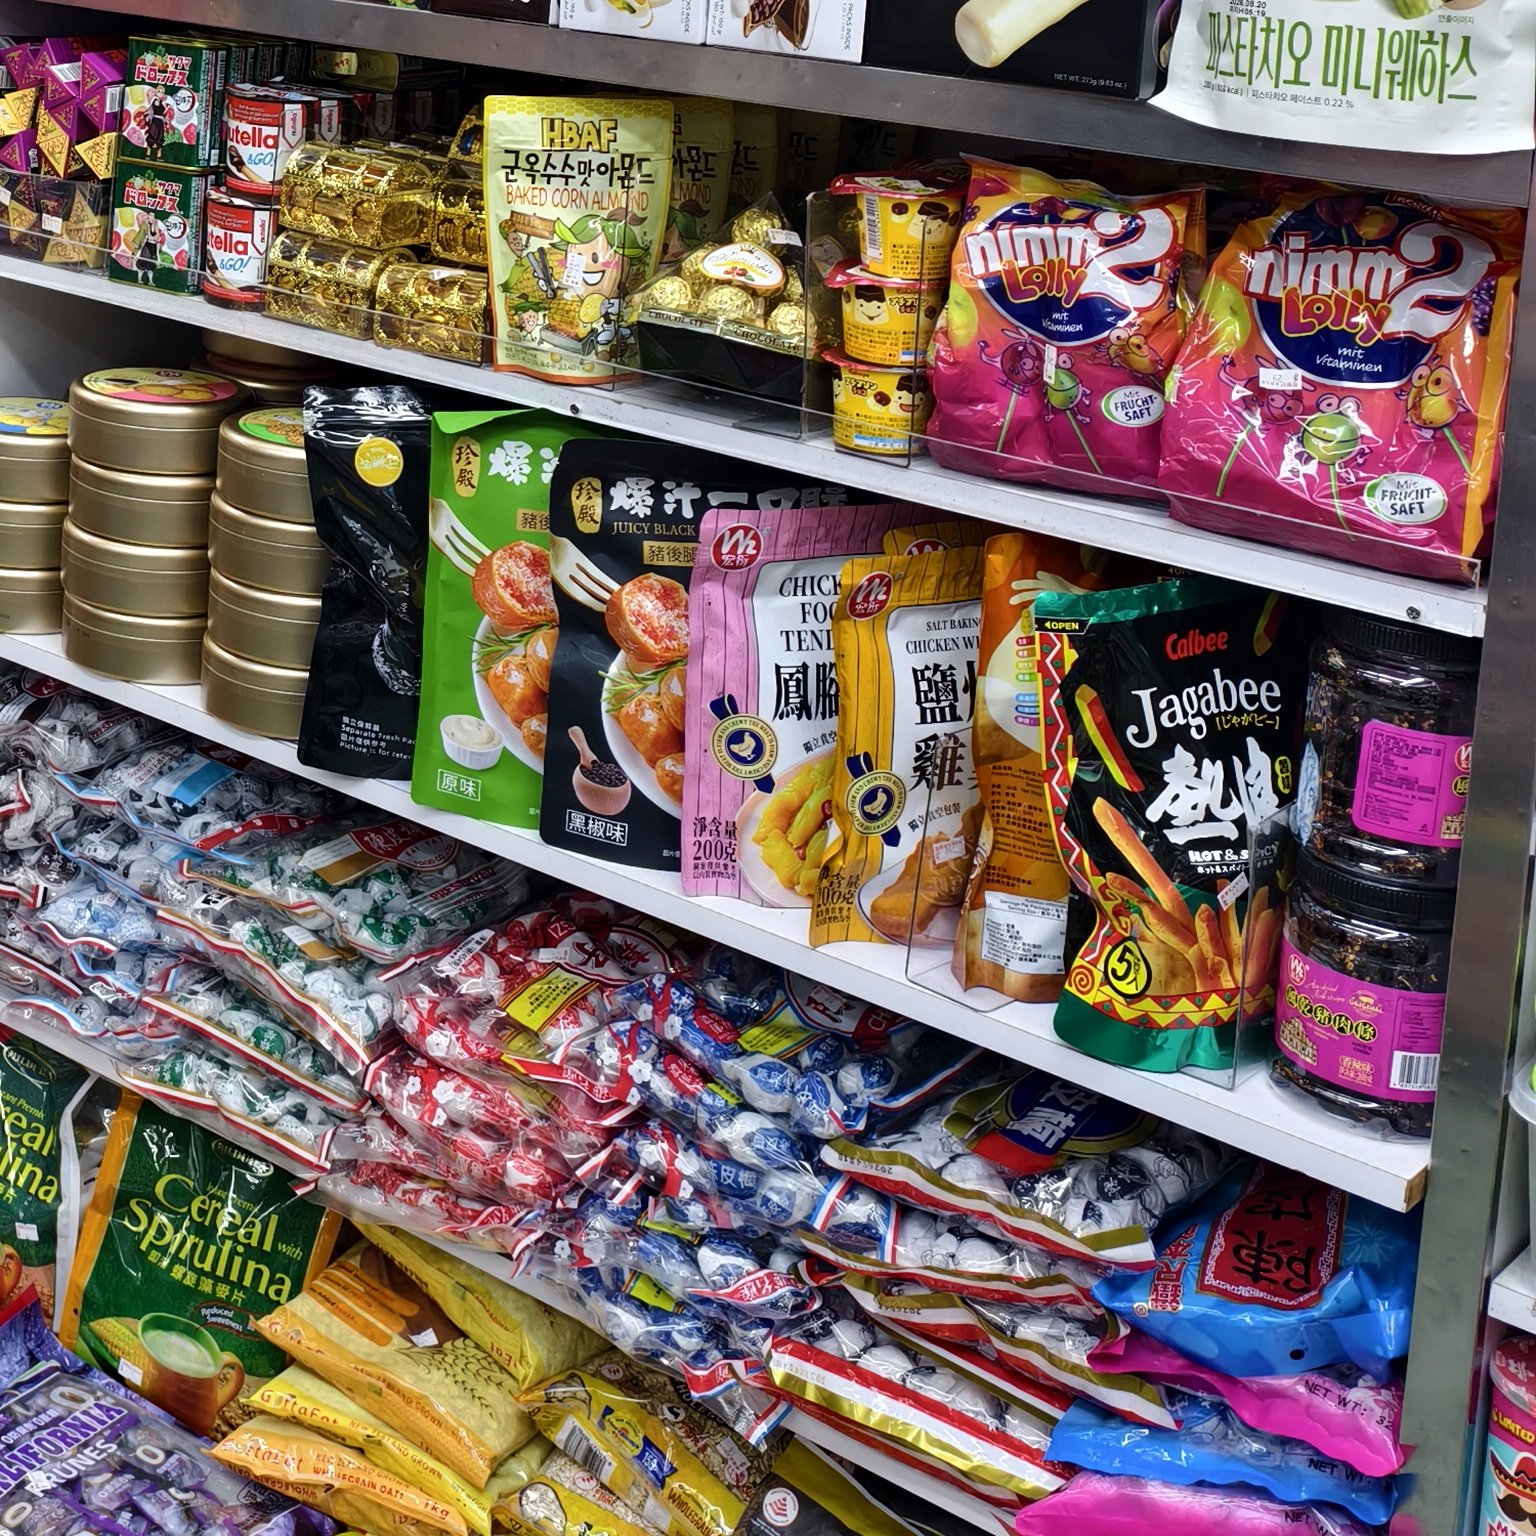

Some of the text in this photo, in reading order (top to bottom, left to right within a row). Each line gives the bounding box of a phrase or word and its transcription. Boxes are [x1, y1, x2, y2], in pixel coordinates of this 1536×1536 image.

[1206, 10, 1478, 104] 피스타치오 미니웨하스
[540, 116, 619, 154] HBAF
[505, 184, 649, 212] BAKED CORN ALMOND
[1003, 259, 1088, 308] Lolly
[1279, 286, 1394, 344] Lolly
[1314, 354, 1384, 373] Vitaminen
[1123, 406, 1153, 423] SAFT
[1389, 500, 1426, 518] SAFT
[612, 520, 696, 537] JUICY BLACK
[926, 619, 948, 633] SALT
[1050, 620, 1081, 633] OPEN
[905, 638, 959, 655] CHICKEN
[1165, 628, 1229, 662] Calbee
[1124, 666, 1283, 748] Jagabee
[341, 725, 400, 743] Separate Fresh
[339, 741, 367, 755] Picture
[440, 773, 478, 799] 原味
[692, 838, 737, 863] 200克
[1187, 849, 1221, 864] HOT
[153, 1171, 305, 1262] Cereal with
[122, 1196, 294, 1305] Spirulina
[1303, 1379, 1331, 1397] NET
[1498, 1416, 1536, 1444] LIMITED
